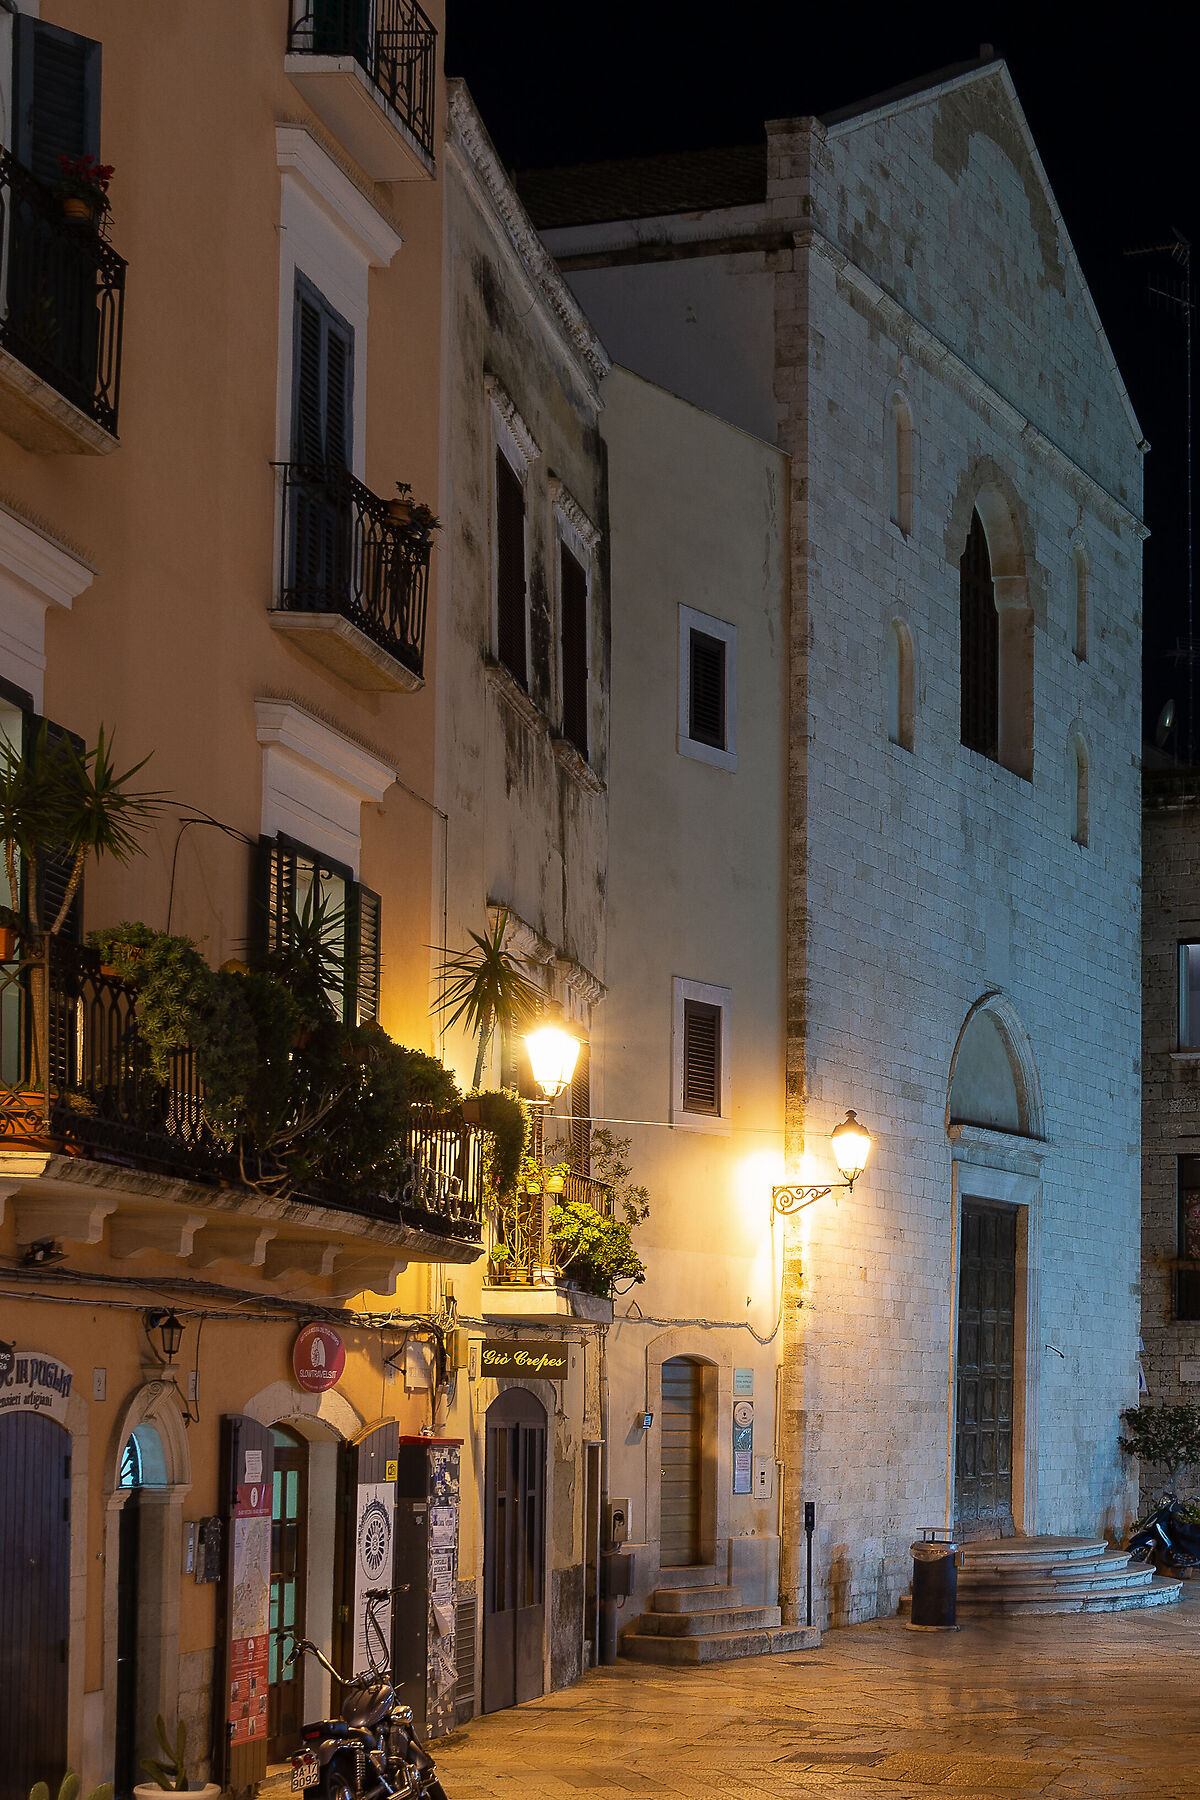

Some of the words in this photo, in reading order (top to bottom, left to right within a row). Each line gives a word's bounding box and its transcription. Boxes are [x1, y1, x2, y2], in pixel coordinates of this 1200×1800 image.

[482, 1349, 512, 1365] Giò
[513, 1350, 567, 1372] Crepes
[293, 1773, 318, 1789] 9092
